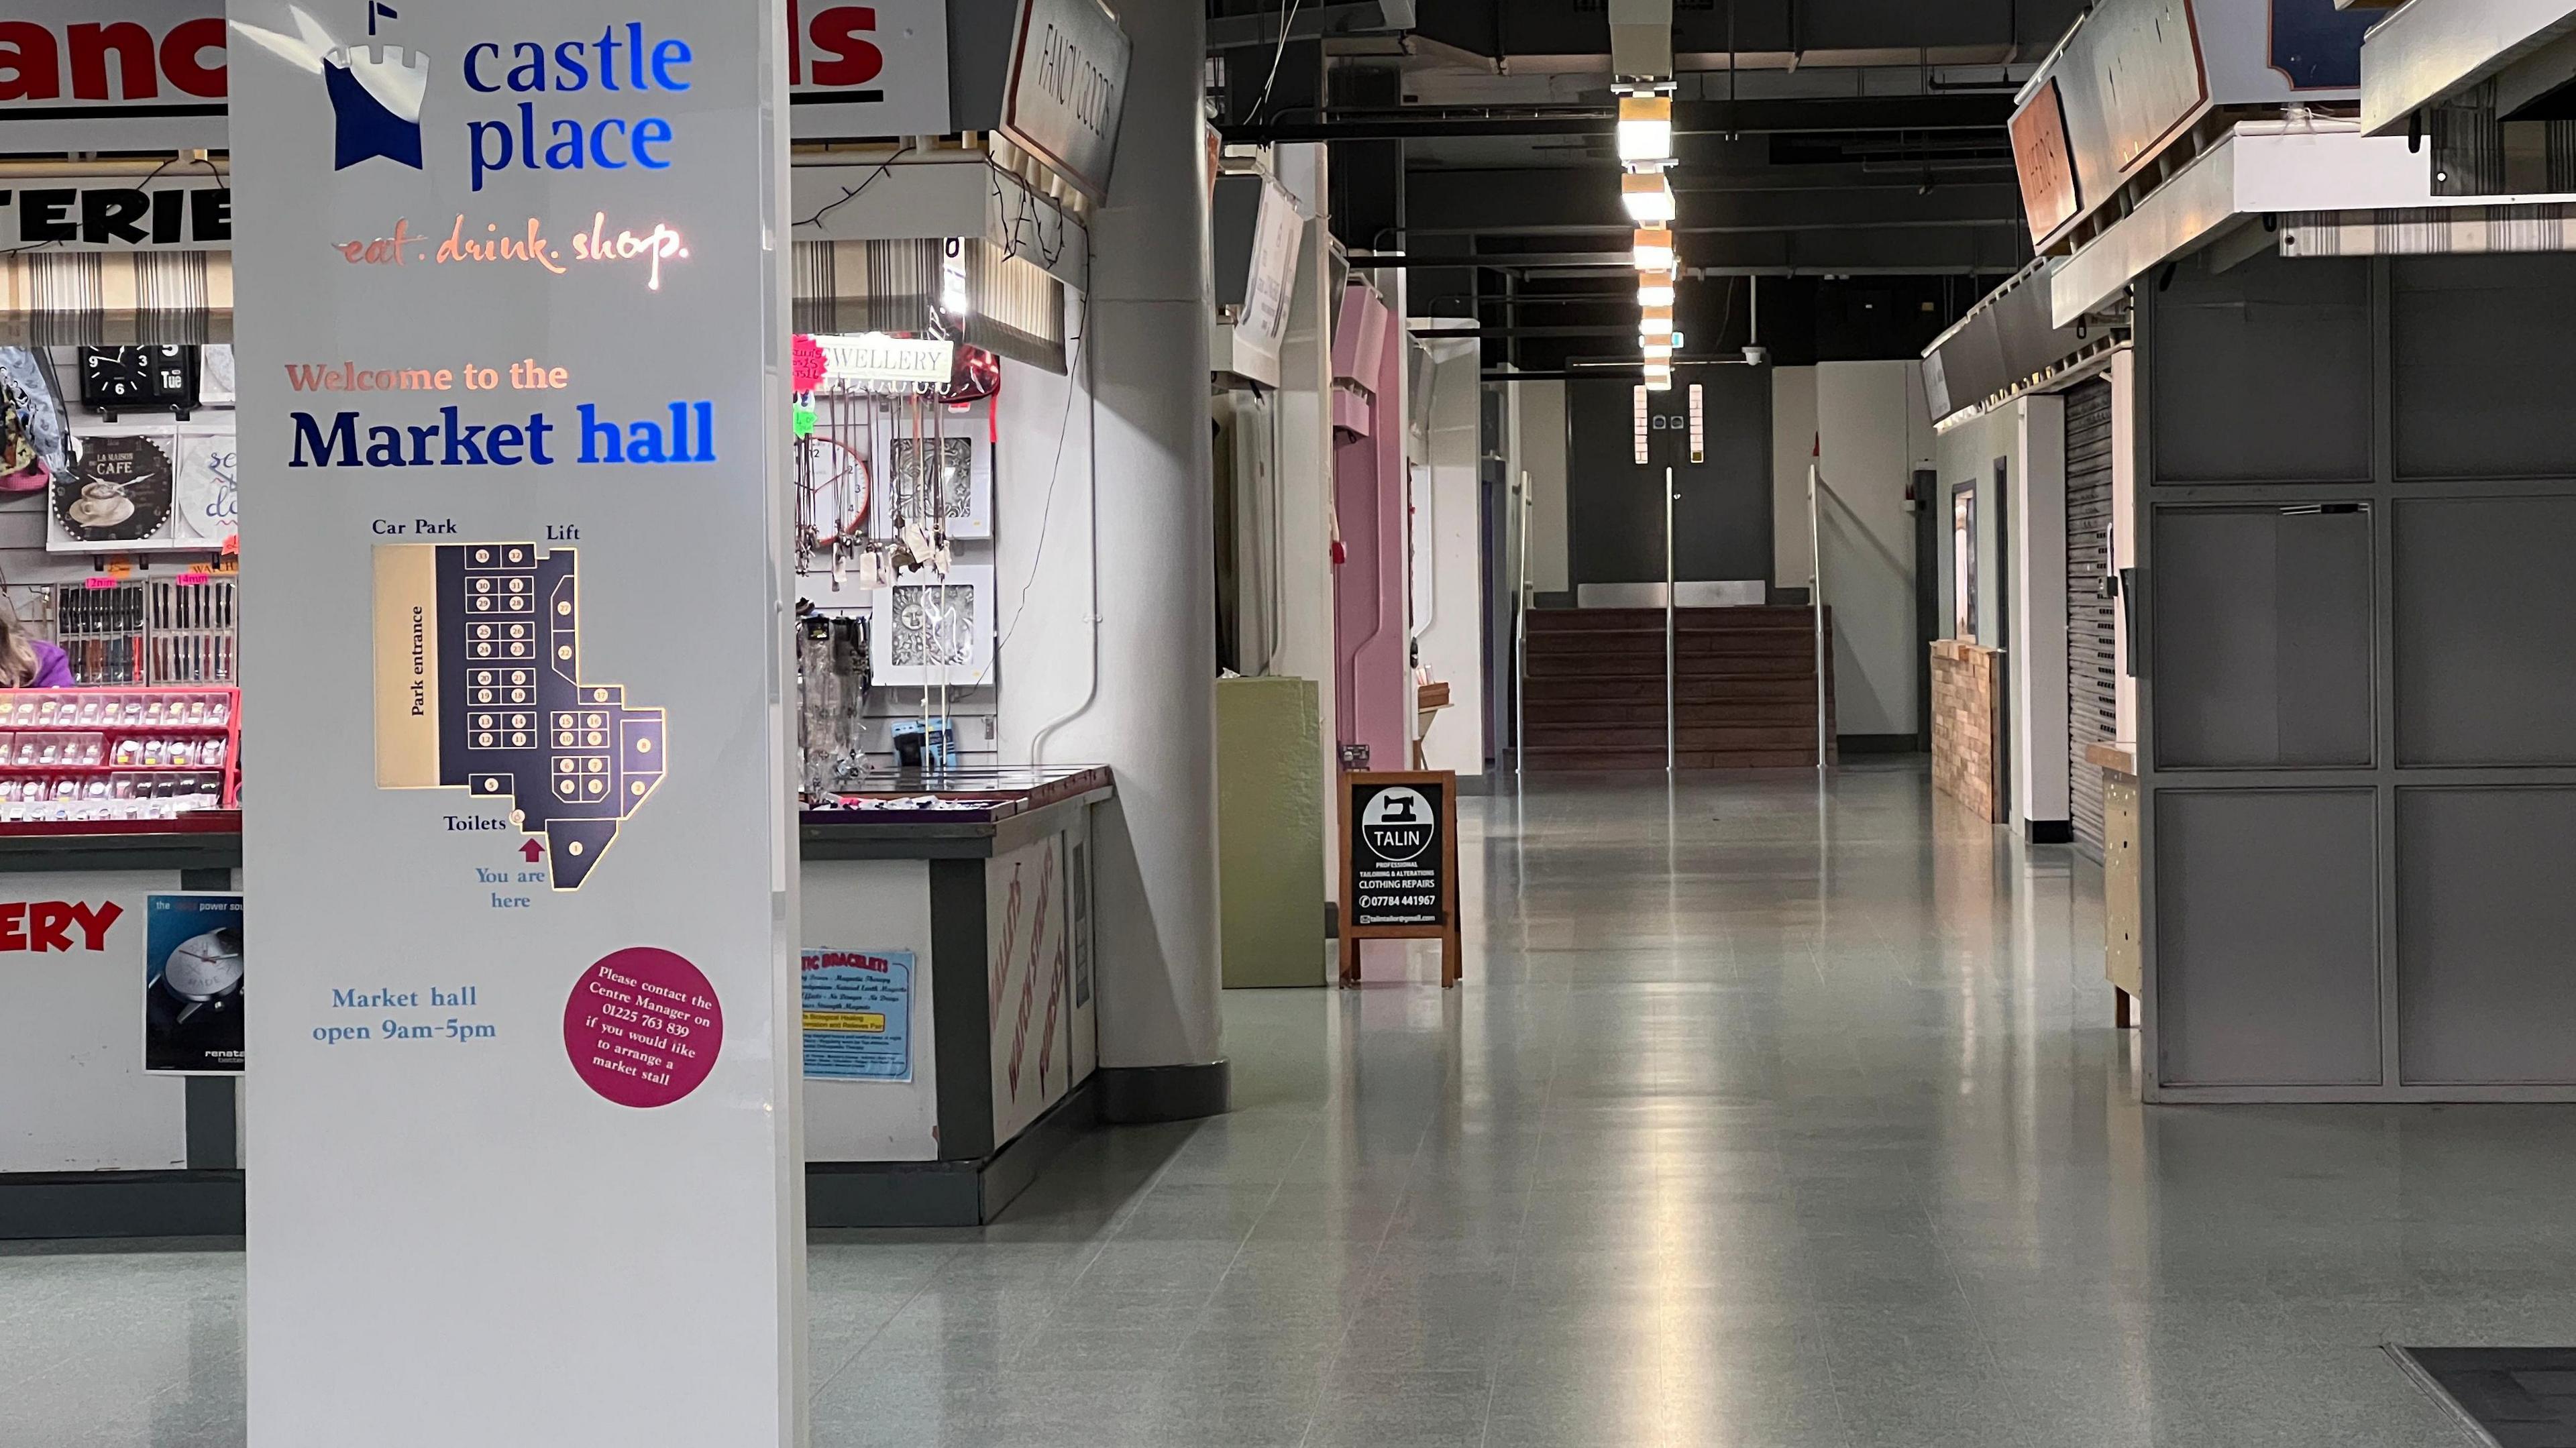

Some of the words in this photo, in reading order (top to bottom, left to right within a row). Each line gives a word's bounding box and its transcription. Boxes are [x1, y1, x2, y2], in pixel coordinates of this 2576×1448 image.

[464, 21, 692, 92] castle
[1038, 23, 1081, 105] FANCY
[1076, 59, 1116, 141] GOODS
[468, 102, 672, 192] place
[0, 188, 231, 244] ERIE
[573, 211, 689, 291] shop.
[138, 355, 148, 367] 3
[285, 361, 453, 393] Welcome
[464, 363, 499, 390] to
[509, 358, 568, 389] the
[115, 383, 125, 395] 6
[161, 371, 182, 388] Tue
[288, 405, 553, 468] Market
[576, 401, 717, 465] hall
[372, 519, 407, 535] Car
[415, 518, 458, 535] Park
[547, 525, 580, 540] Lift
[193, 561, 233, 574] WACH
[412, 606, 423, 672] entrance
[411, 675, 424, 716] Park
[443, 816, 506, 831] Toilets
[1374, 831, 1419, 846] TALIN
[476, 868, 508, 883] You
[517, 871, 545, 883] are
[1359, 881, 1400, 889] CLOTHING
[1402, 879, 1435, 888] REPAIRS
[156, 901, 170, 910] the
[199, 902, 227, 911] power
[491, 893, 530, 907] here
[1371, 896, 1399, 906] 07784
[1401, 895, 1435, 905] 441967
[822, 953, 888, 973] BRACELETS
[332, 988, 419, 1008] Market
[431, 986, 478, 1006] hall
[598, 966, 637, 987] Please
[641, 982, 687, 1002] contact
[692, 995, 712, 1010] the
[589, 981, 631, 1003] Centre
[635, 995, 691, 1022] Manager
[694, 1017, 710, 1027] on
[1039, 932, 1063, 1099] PURSES
[313, 1021, 371, 1043] open
[382, 1019, 496, 1043] 9am-5pm
[602, 1003, 639, 1022] 01225
[642, 1015, 663, 1030] 763
[666, 1023, 690, 1038] 839
[1008, 960, 1032, 1103] WATCH
[586, 1015, 598, 1027] if
[601, 1022, 623, 1037] you
[629, 1031, 667, 1050] would
[671, 1040, 696, 1058] like
[597, 1039, 610, 1050] to
[614, 1046, 661, 1066] arrange
[666, 1060, 674, 1070] a
[592, 1057, 637, 1076] market
[641, 1070, 669, 1086] stall
